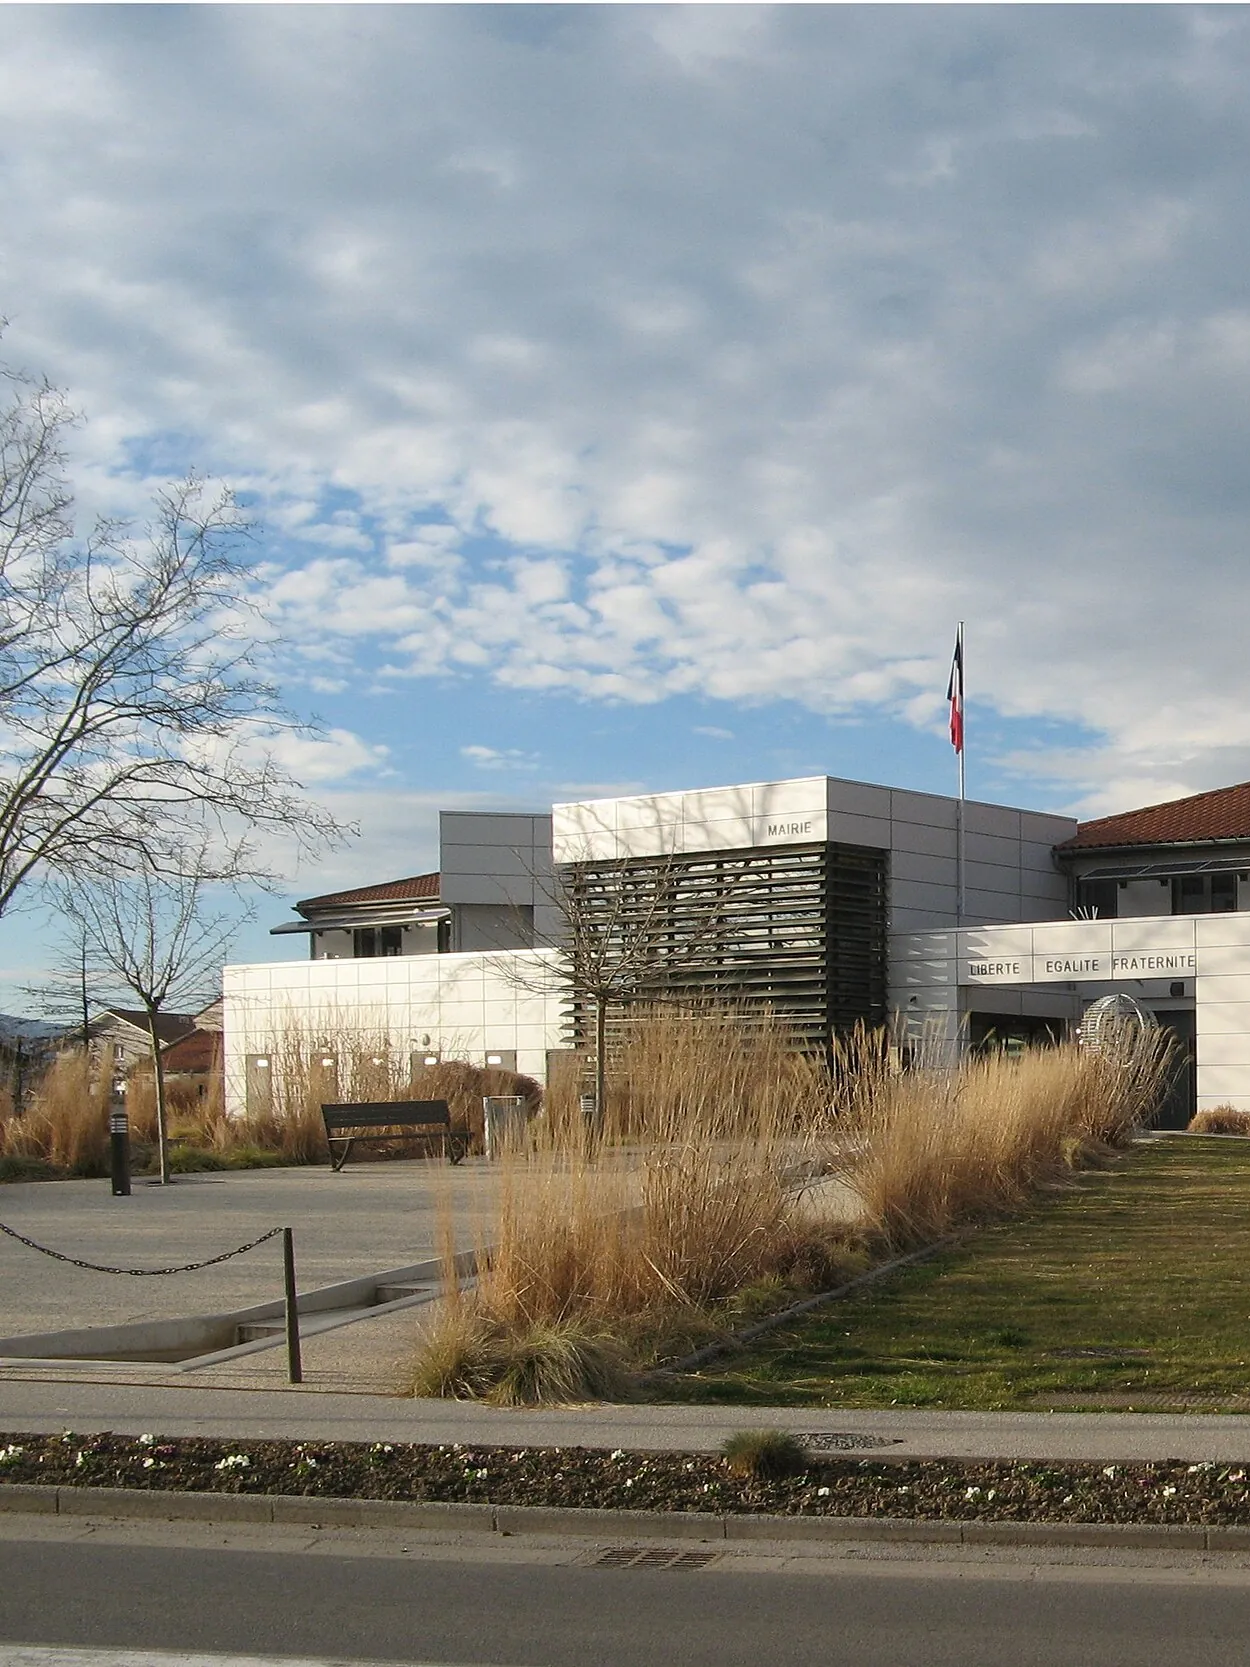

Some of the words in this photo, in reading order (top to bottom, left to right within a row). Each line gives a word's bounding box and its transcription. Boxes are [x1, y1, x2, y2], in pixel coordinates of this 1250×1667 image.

[768, 821, 812, 837] MAIRIE
[970, 963, 1020, 976] LIBERTE
[1046, 960, 1100, 973] EGALITE
[1113, 955, 1195, 970] FRATERNITE
